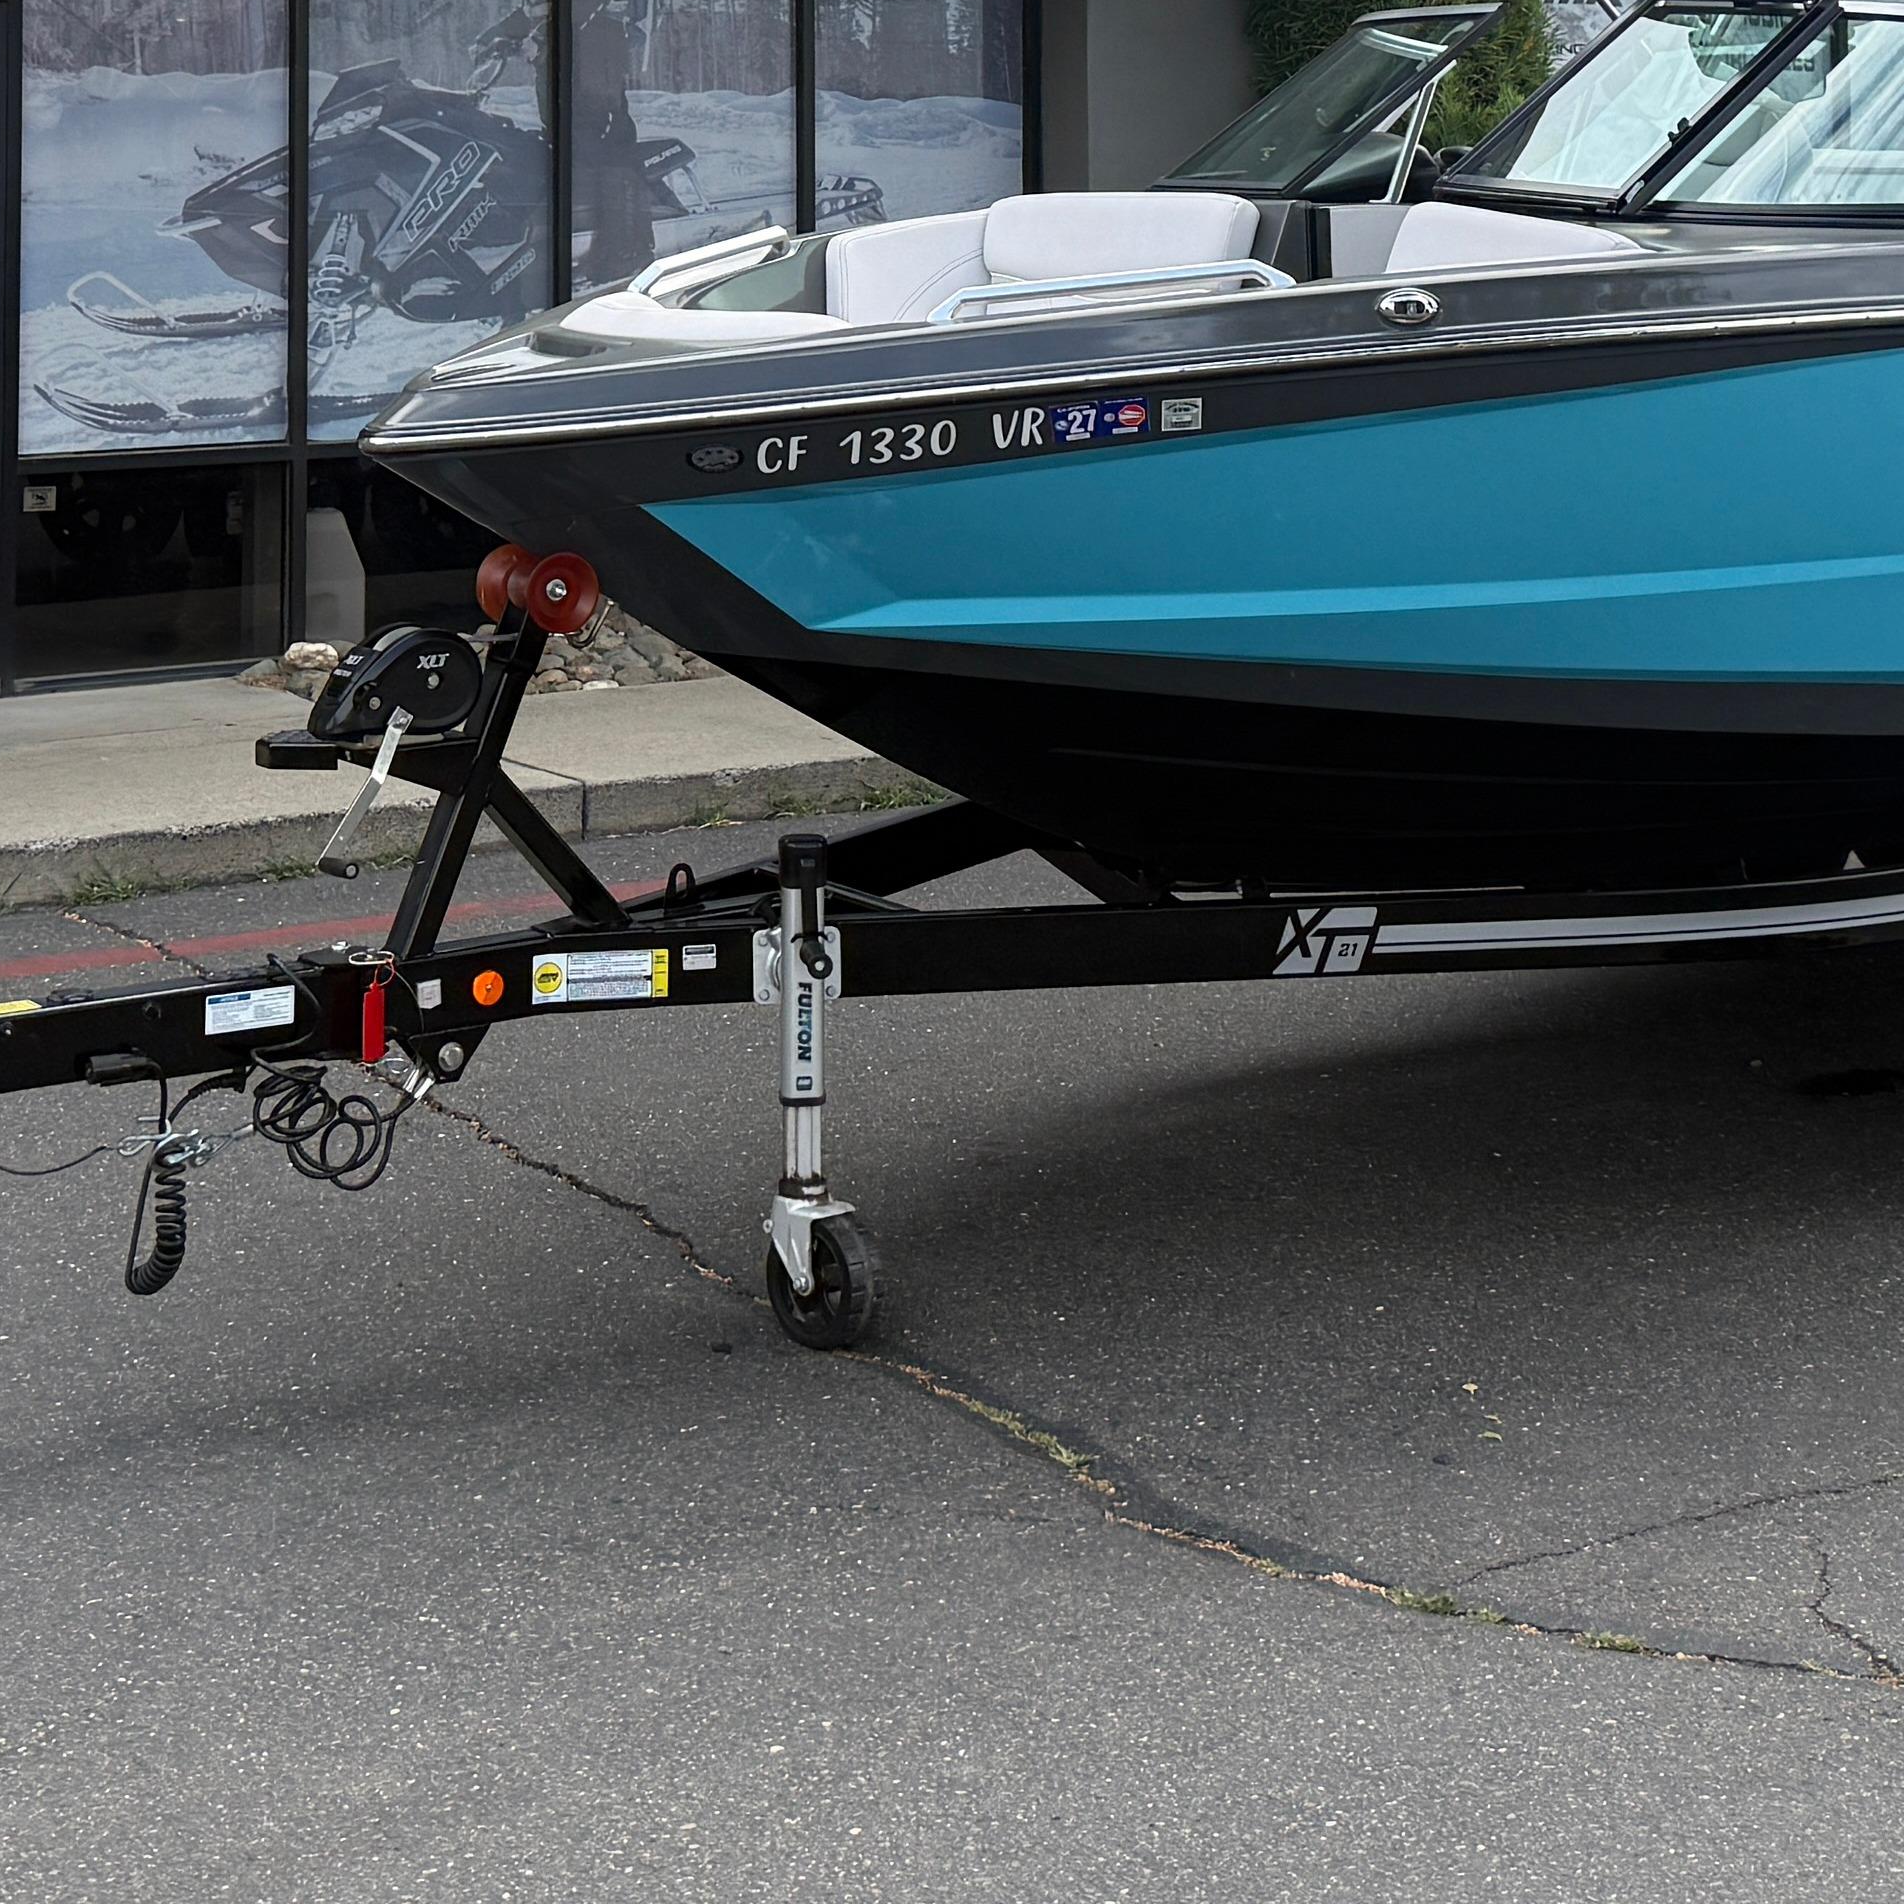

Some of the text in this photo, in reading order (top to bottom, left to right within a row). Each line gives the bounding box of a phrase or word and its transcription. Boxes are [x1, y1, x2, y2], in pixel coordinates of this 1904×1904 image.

[401, 139, 482, 244] PRO
[756, 435, 808, 474] CF
[838, 419, 957, 465] 1330
[992, 406, 1046, 450] VR
[415, 652, 451, 671] XLT
[797, 981, 814, 1063] FULTON
